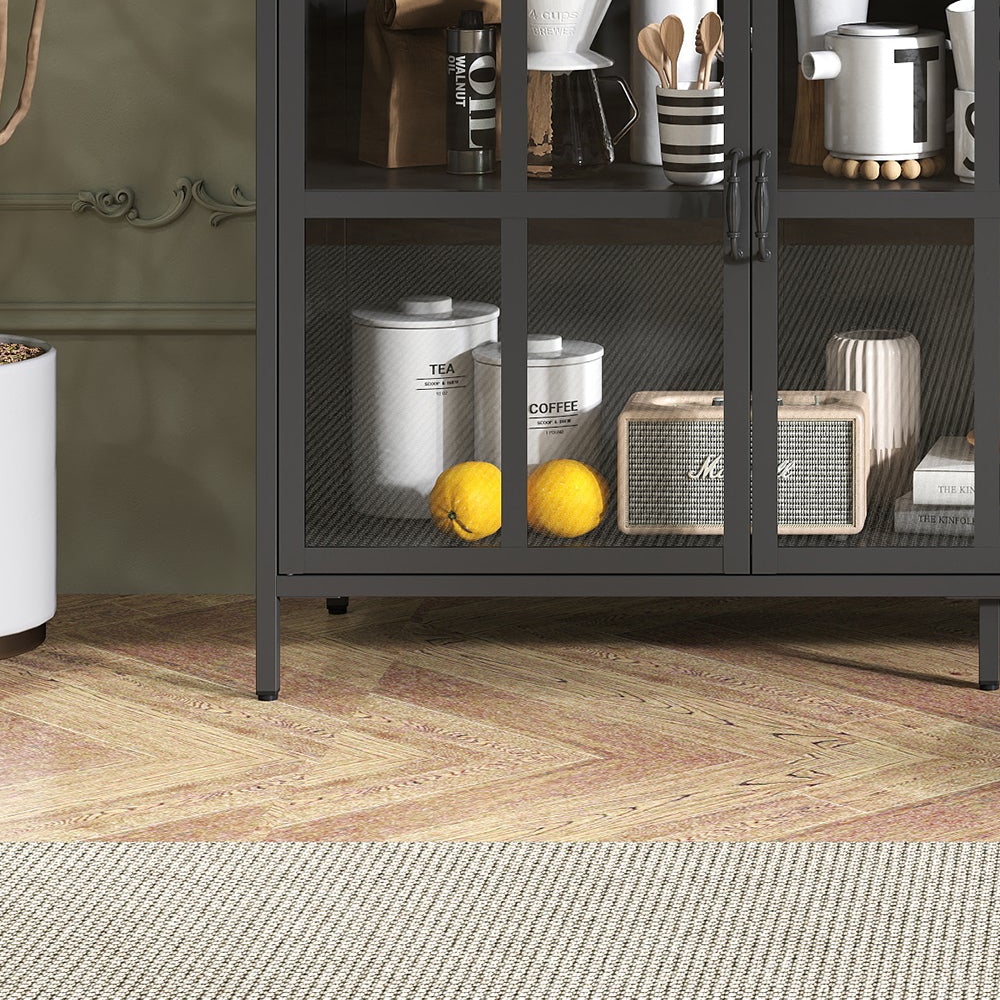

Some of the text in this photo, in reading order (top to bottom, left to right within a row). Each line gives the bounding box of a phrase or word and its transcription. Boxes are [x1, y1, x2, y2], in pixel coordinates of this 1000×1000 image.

[541, 10, 579, 24] cups
[447, 55, 456, 76] OIL
[455, 55, 466, 108] WALNUT
[893, 45, 939, 143] T
[468, 55, 496, 149] OIL
[429, 363, 455, 375] TEA
[529, 400, 578, 414] COFFEE
[938, 485, 957, 494] THE
[918, 515, 936, 524] THE
